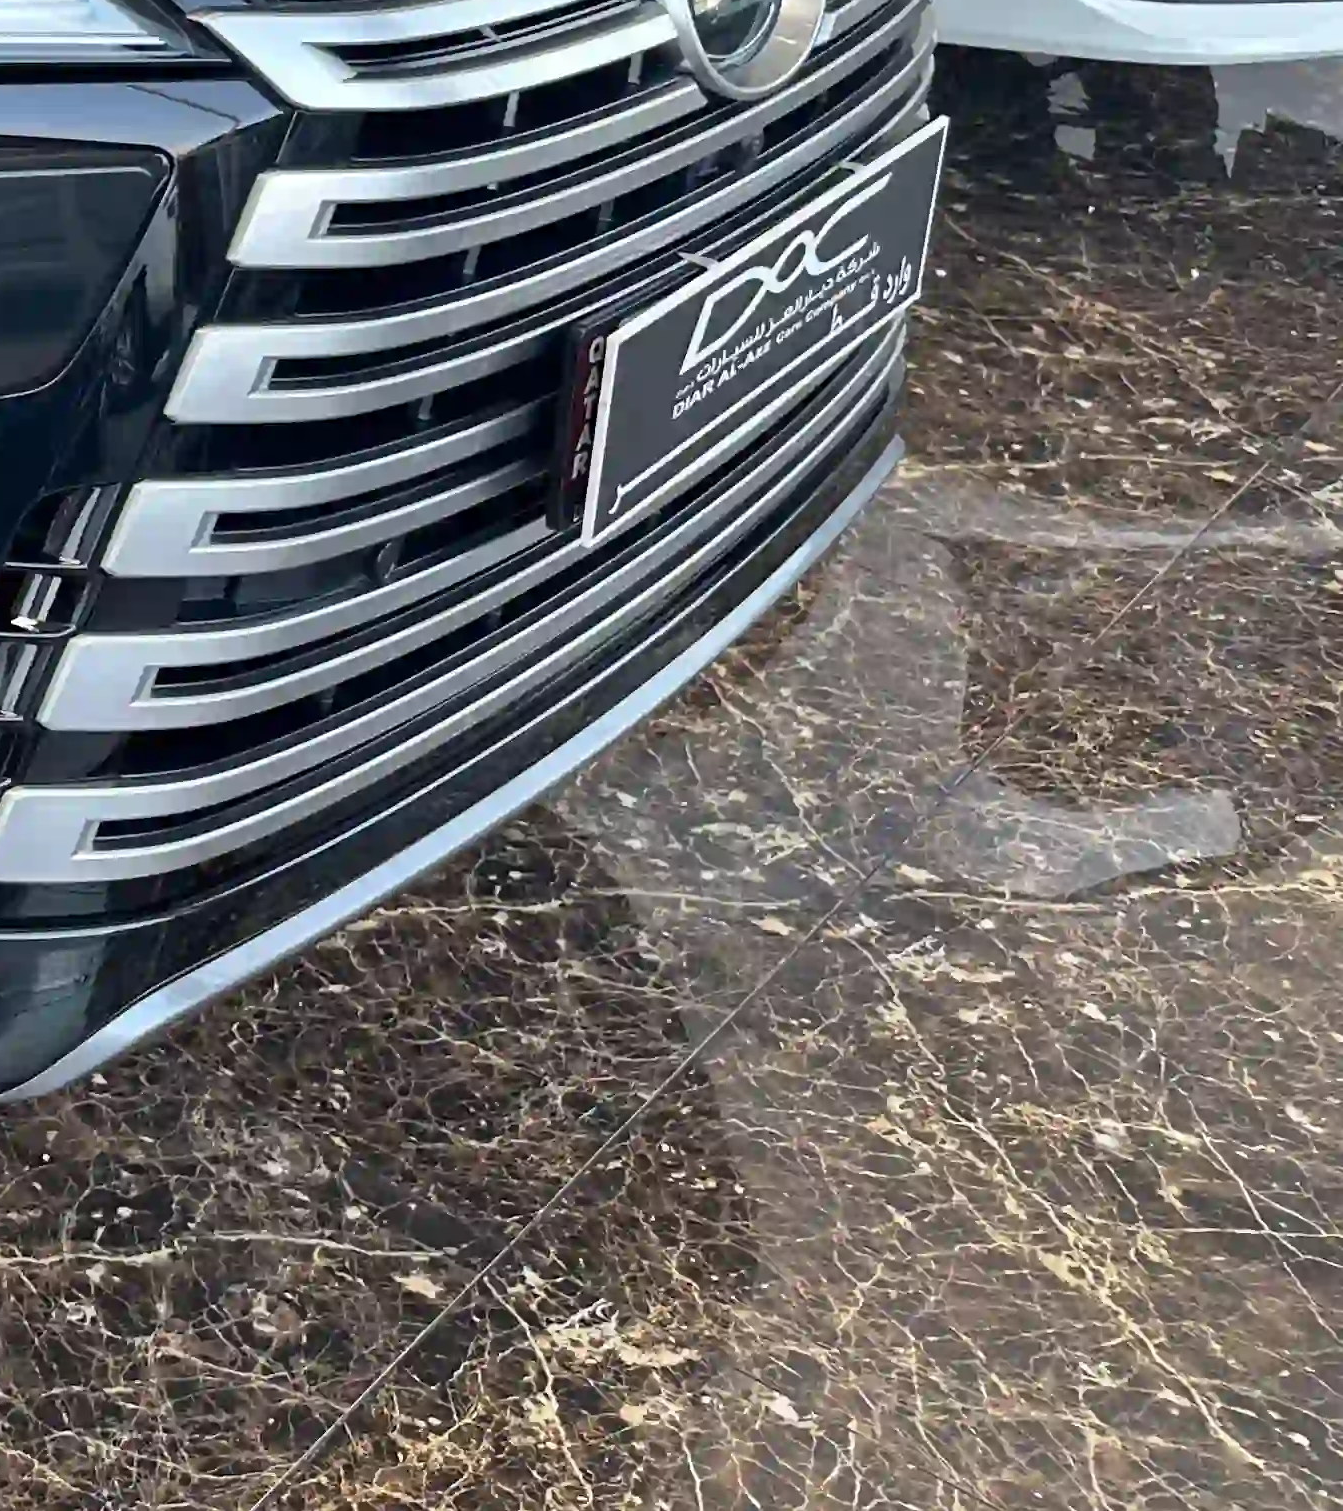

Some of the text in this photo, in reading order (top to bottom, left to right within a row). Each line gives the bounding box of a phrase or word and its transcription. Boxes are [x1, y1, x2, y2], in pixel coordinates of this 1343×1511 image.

[571, 335, 605, 480] QATAR
[609, 255, 912, 515] وارد قطر
[671, 378, 714, 421] DIAR
